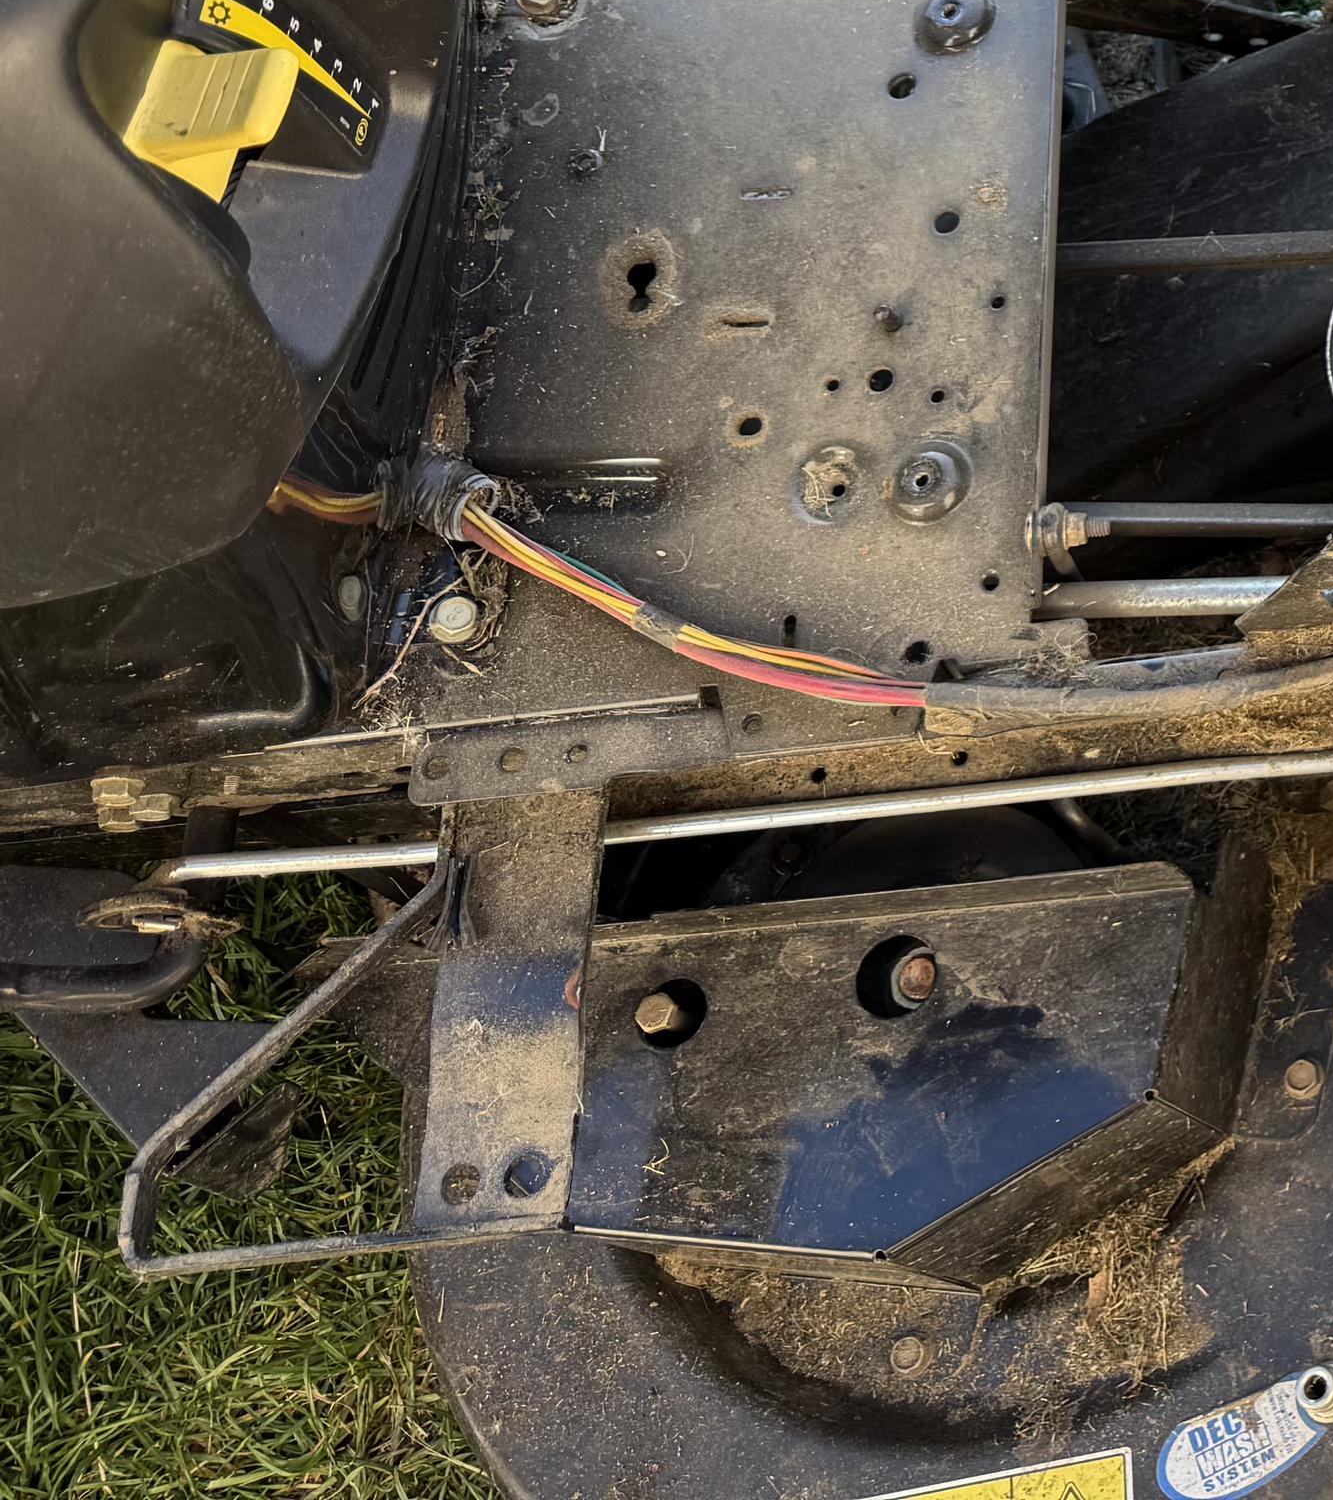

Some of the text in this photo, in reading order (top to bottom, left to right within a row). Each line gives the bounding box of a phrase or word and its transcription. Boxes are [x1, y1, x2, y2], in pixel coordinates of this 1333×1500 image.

[289, 16, 300, 33] 5
[313, 37, 323, 54] 4
[333, 58, 343, 74] 3
[352, 77, 363, 94] 2
[371, 98, 380, 109] 1
[1187, 1406, 1257, 1453] DEC
[1203, 1447, 1276, 1493] SYSTEM
